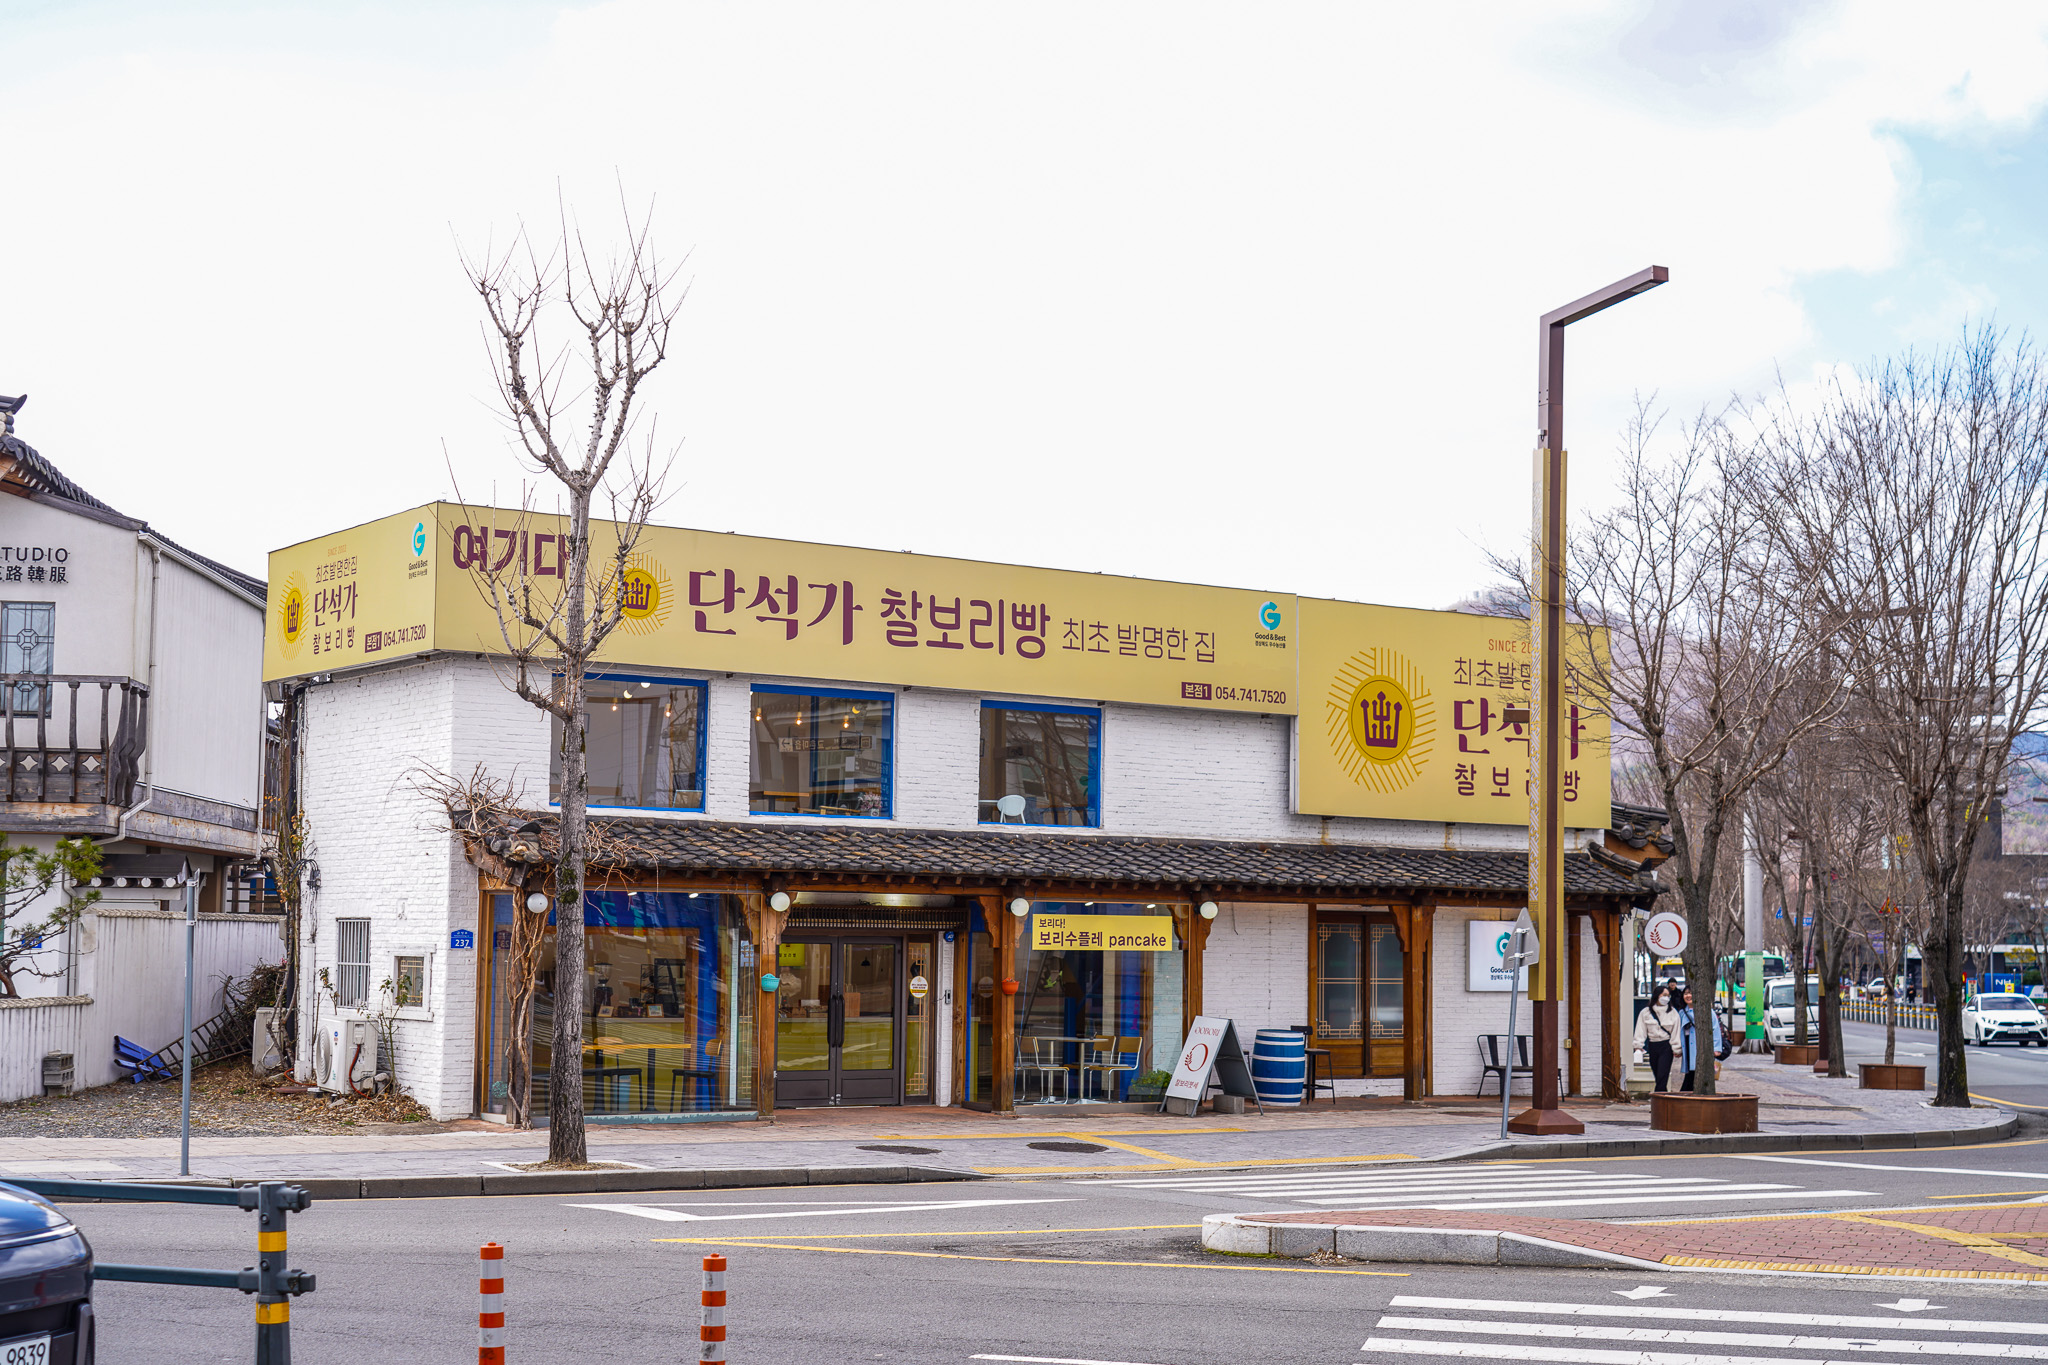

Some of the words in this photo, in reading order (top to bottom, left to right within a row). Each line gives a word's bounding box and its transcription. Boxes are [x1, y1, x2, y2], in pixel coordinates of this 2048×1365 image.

[0, 565, 68, 583] 路韓服
[314, 580, 359, 627] 단석가
[689, 568, 863, 645] 단석가
[880, 588, 1051, 659] 찰보리빵
[312, 626, 355, 655] 찰보리빵
[383, 623, 427, 647] 054.741.7520
[1488, 638, 1517, 653] SINCE
[1185, 683, 1209, 698] 본점1
[1215, 686, 1287, 704] 054.741.7520
[1454, 763, 1581, 802] 찰보빵
[1038, 918, 1066, 929] 보리다!
[455, 939, 470, 947] 237
[1038, 931, 1103, 947] 보리수플레
[1109, 933, 1167, 948] pancake
[6, 1342, 46, 1365] 9839
